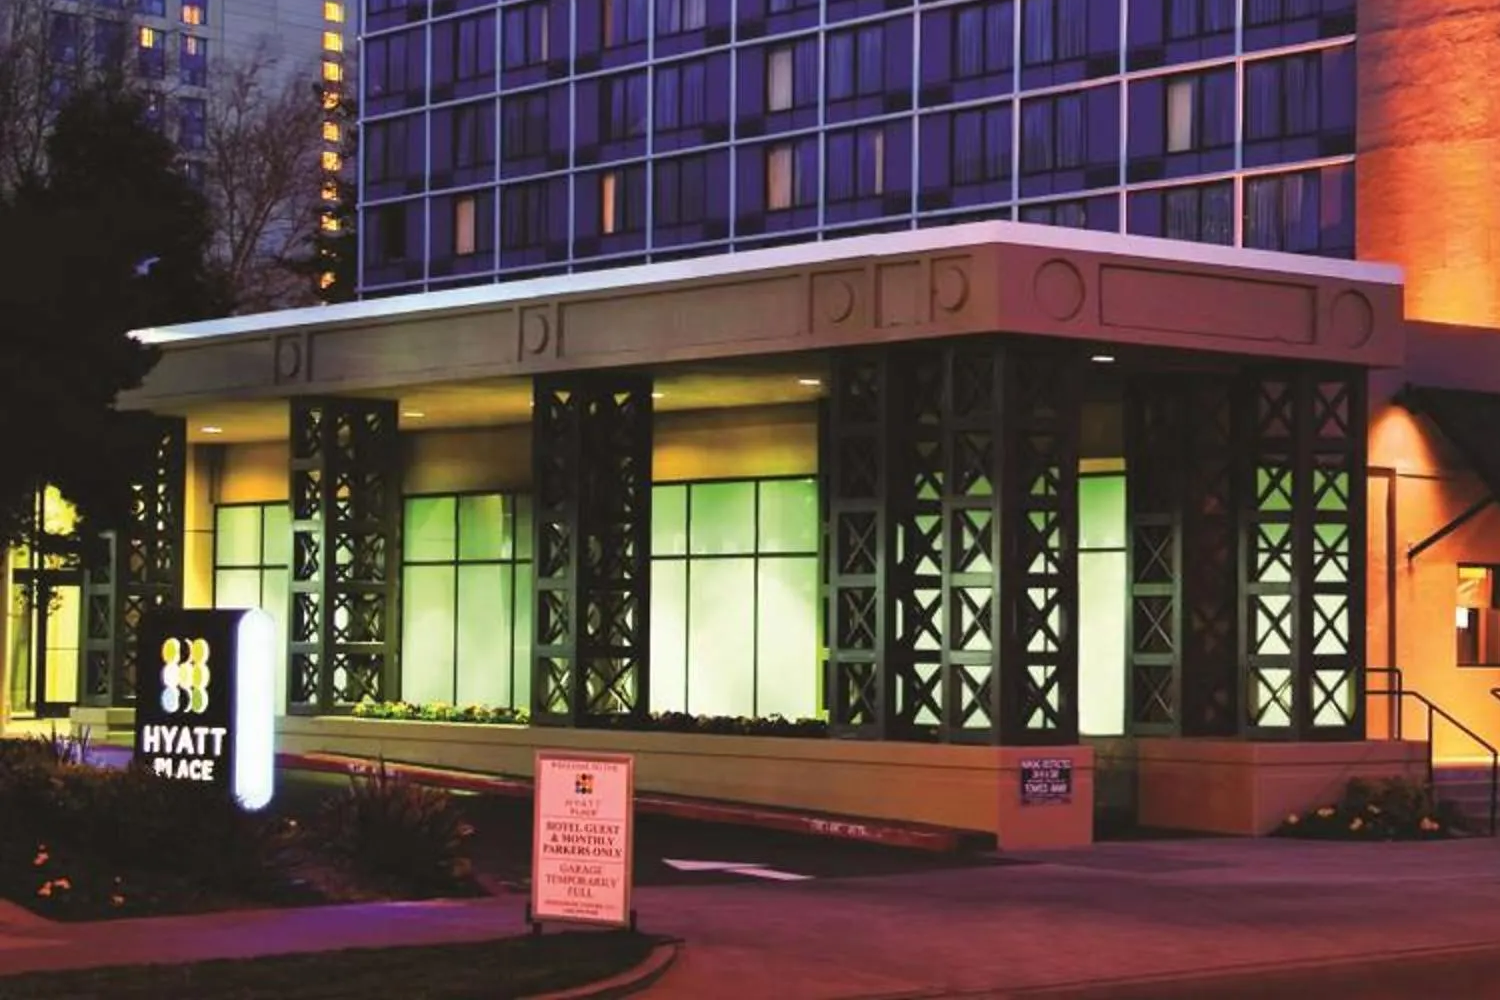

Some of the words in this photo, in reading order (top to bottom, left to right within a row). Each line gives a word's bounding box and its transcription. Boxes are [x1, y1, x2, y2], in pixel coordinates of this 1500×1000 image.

[143, 724, 227, 756] HYATT
[154, 757, 215, 781] PLACE
[546, 821, 583, 833] HOTEL
[584, 823, 620, 835] GUEST
[561, 833, 615, 847] MONTHLY
[543, 843, 591, 857] PARKERS
[592, 847, 623, 858] ONLY
[559, 864, 603, 875] GARAGE
[567, 885, 595, 898] FULL
